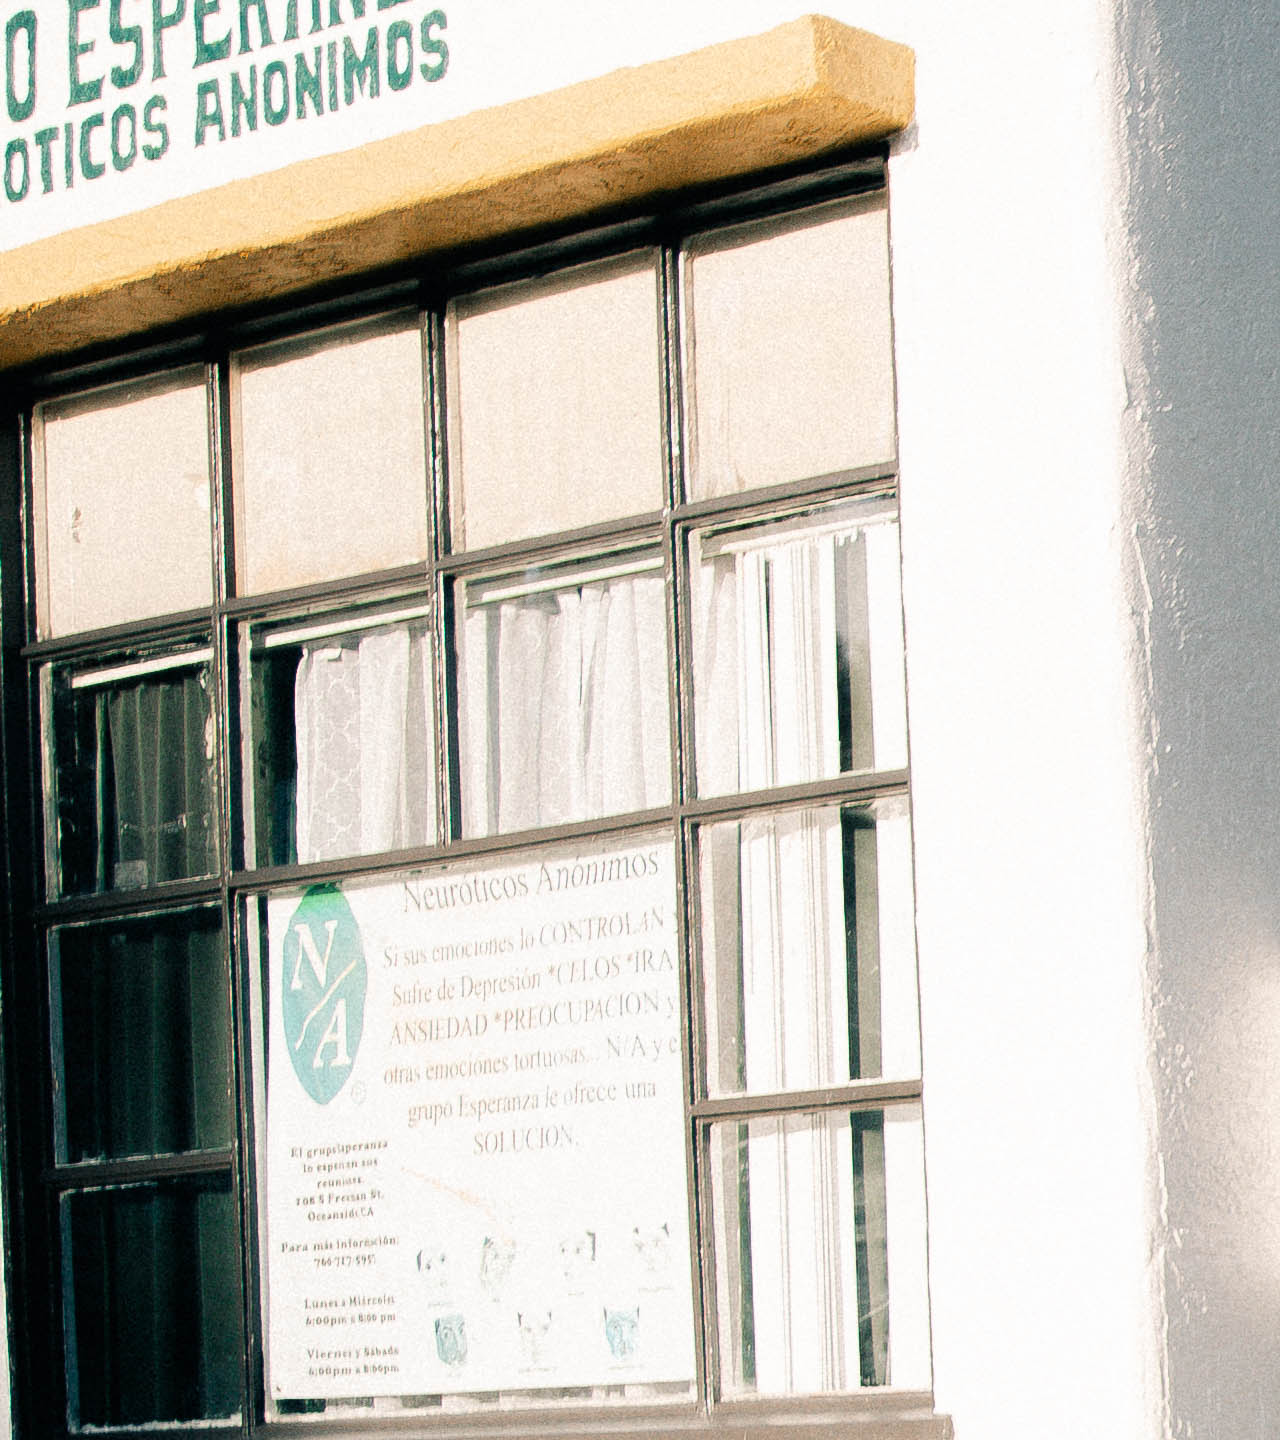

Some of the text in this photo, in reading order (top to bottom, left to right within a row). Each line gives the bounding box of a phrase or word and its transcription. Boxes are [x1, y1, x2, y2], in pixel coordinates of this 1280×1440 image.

[5, 10, 37, 122] O
[4, 9, 449, 203] OTICOS ANONIMOS
[401, 850, 659, 913] Neuróticos Anónimos
[383, 945, 399, 968] Si
[403, 945, 427, 966] sus
[431, 934, 514, 962] emociones
[520, 927, 535, 951] lo
[539, 904, 664, 947] CONTROLAN
[392, 982, 432, 1007] Sufre
[437, 976, 455, 1000] de
[460, 967, 541, 1001] Depresión
[389, 1013, 488, 1047] ANSIEDAD
[383, 1062, 421, 1087] otras
[425, 1054, 509, 1081] emociones
[407, 1079, 656, 1128] grupo Esperanza le ofrece una
